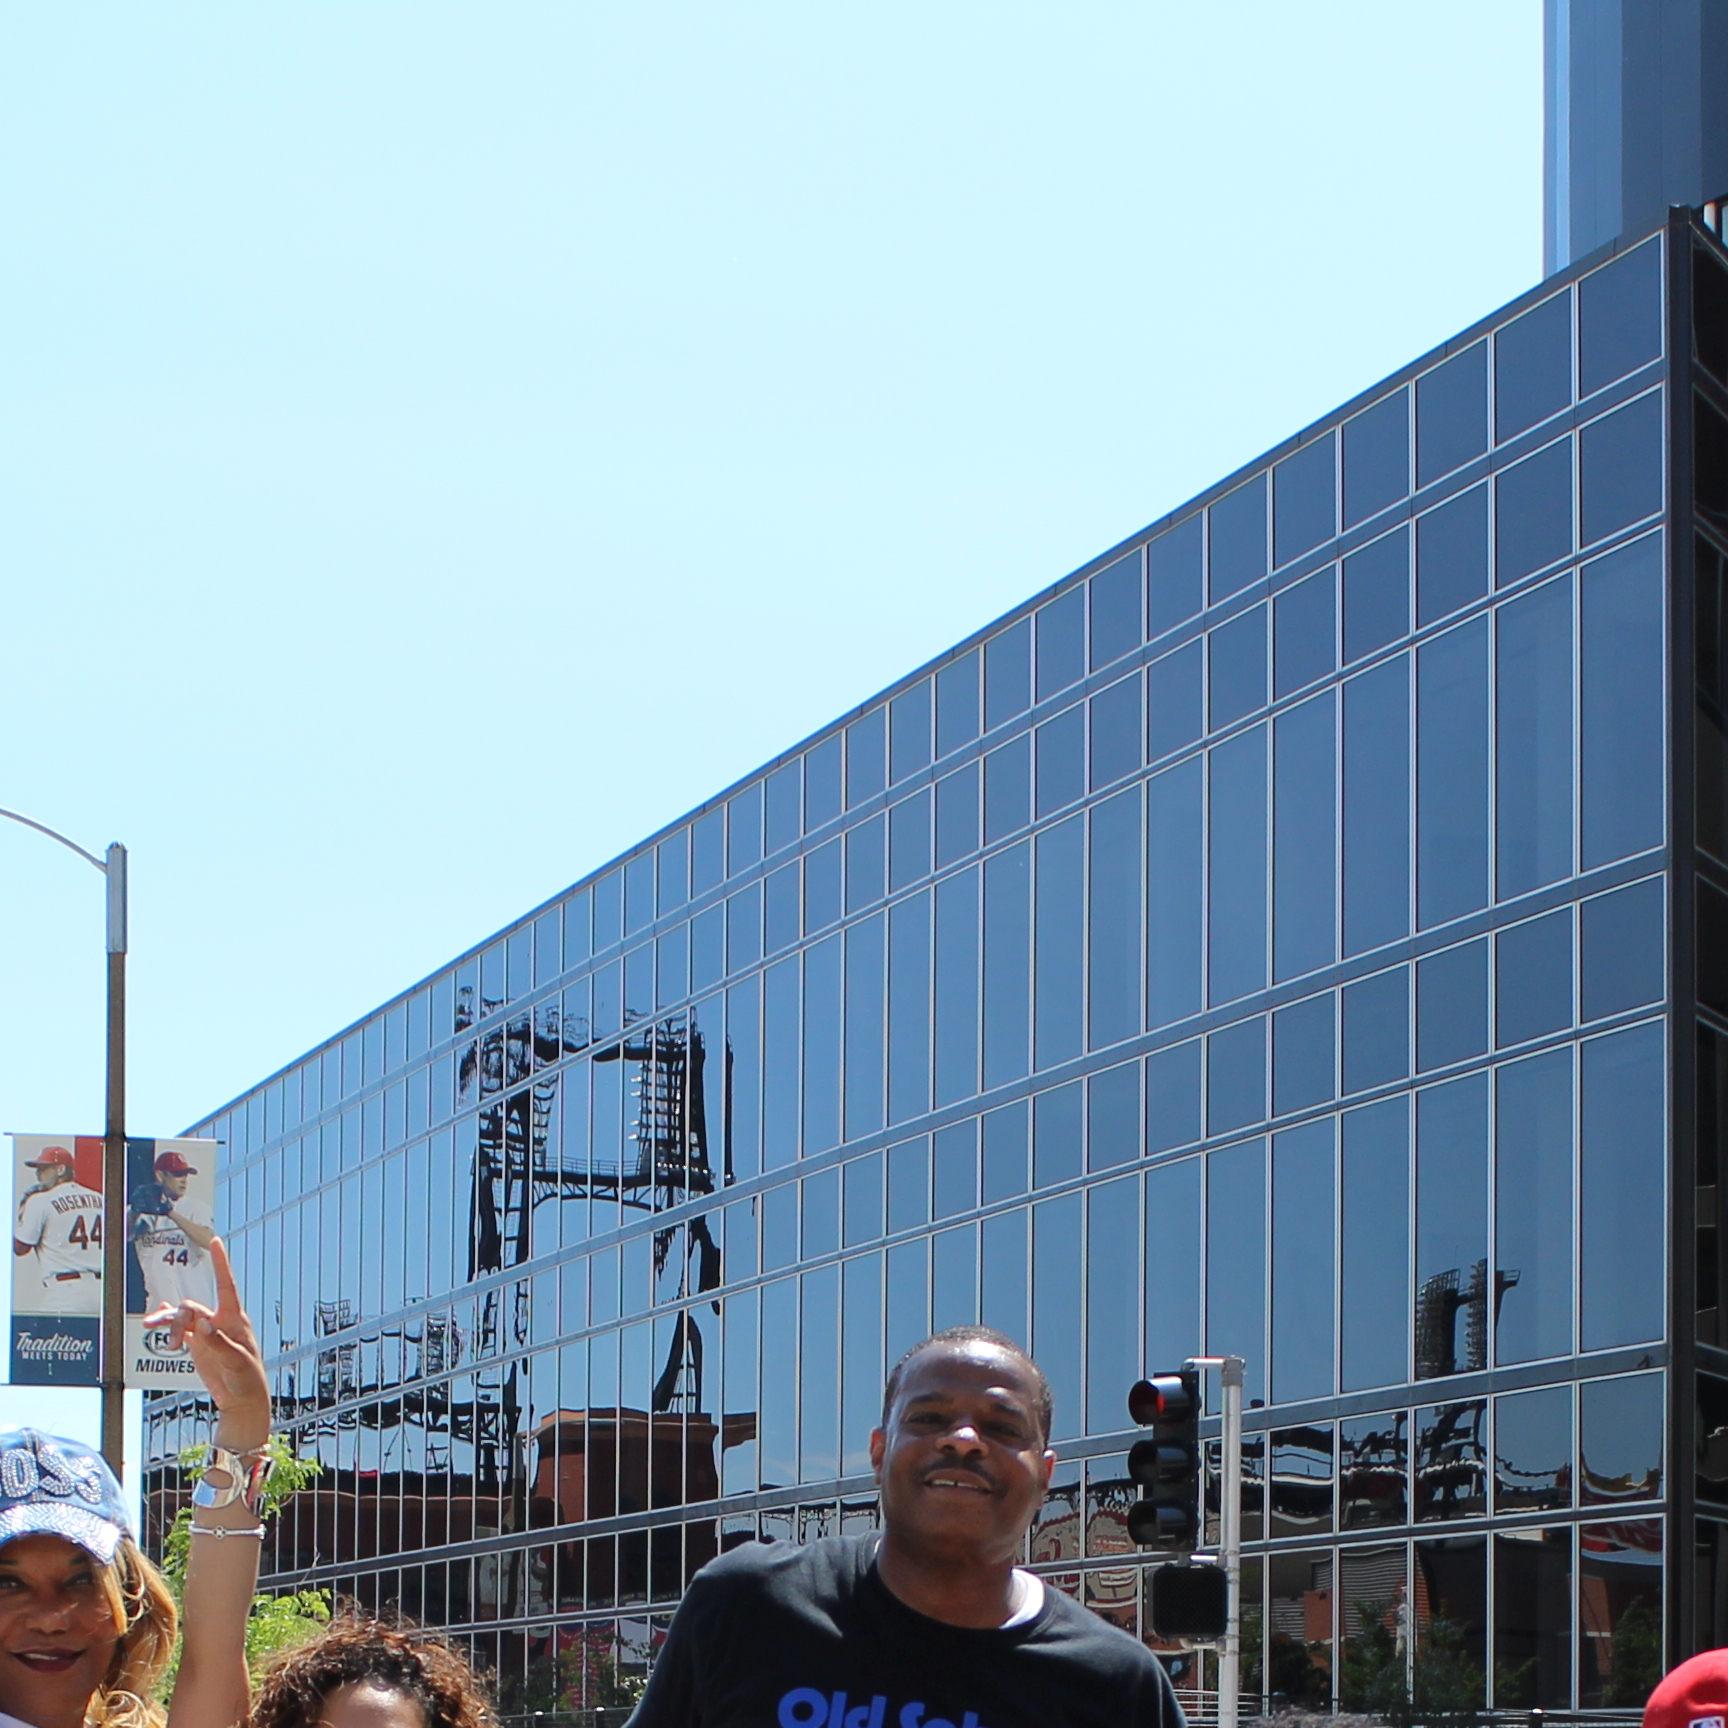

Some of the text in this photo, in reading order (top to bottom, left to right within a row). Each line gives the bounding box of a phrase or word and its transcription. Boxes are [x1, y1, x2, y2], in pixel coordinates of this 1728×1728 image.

[68, 1214, 103, 1250] 44
[161, 1248, 190, 1267] 44
[16, 1331, 94, 1354] Tradition
[22, 1351, 88, 1361] MEETS TODAY
[135, 1358, 195, 1374] MIDWES
